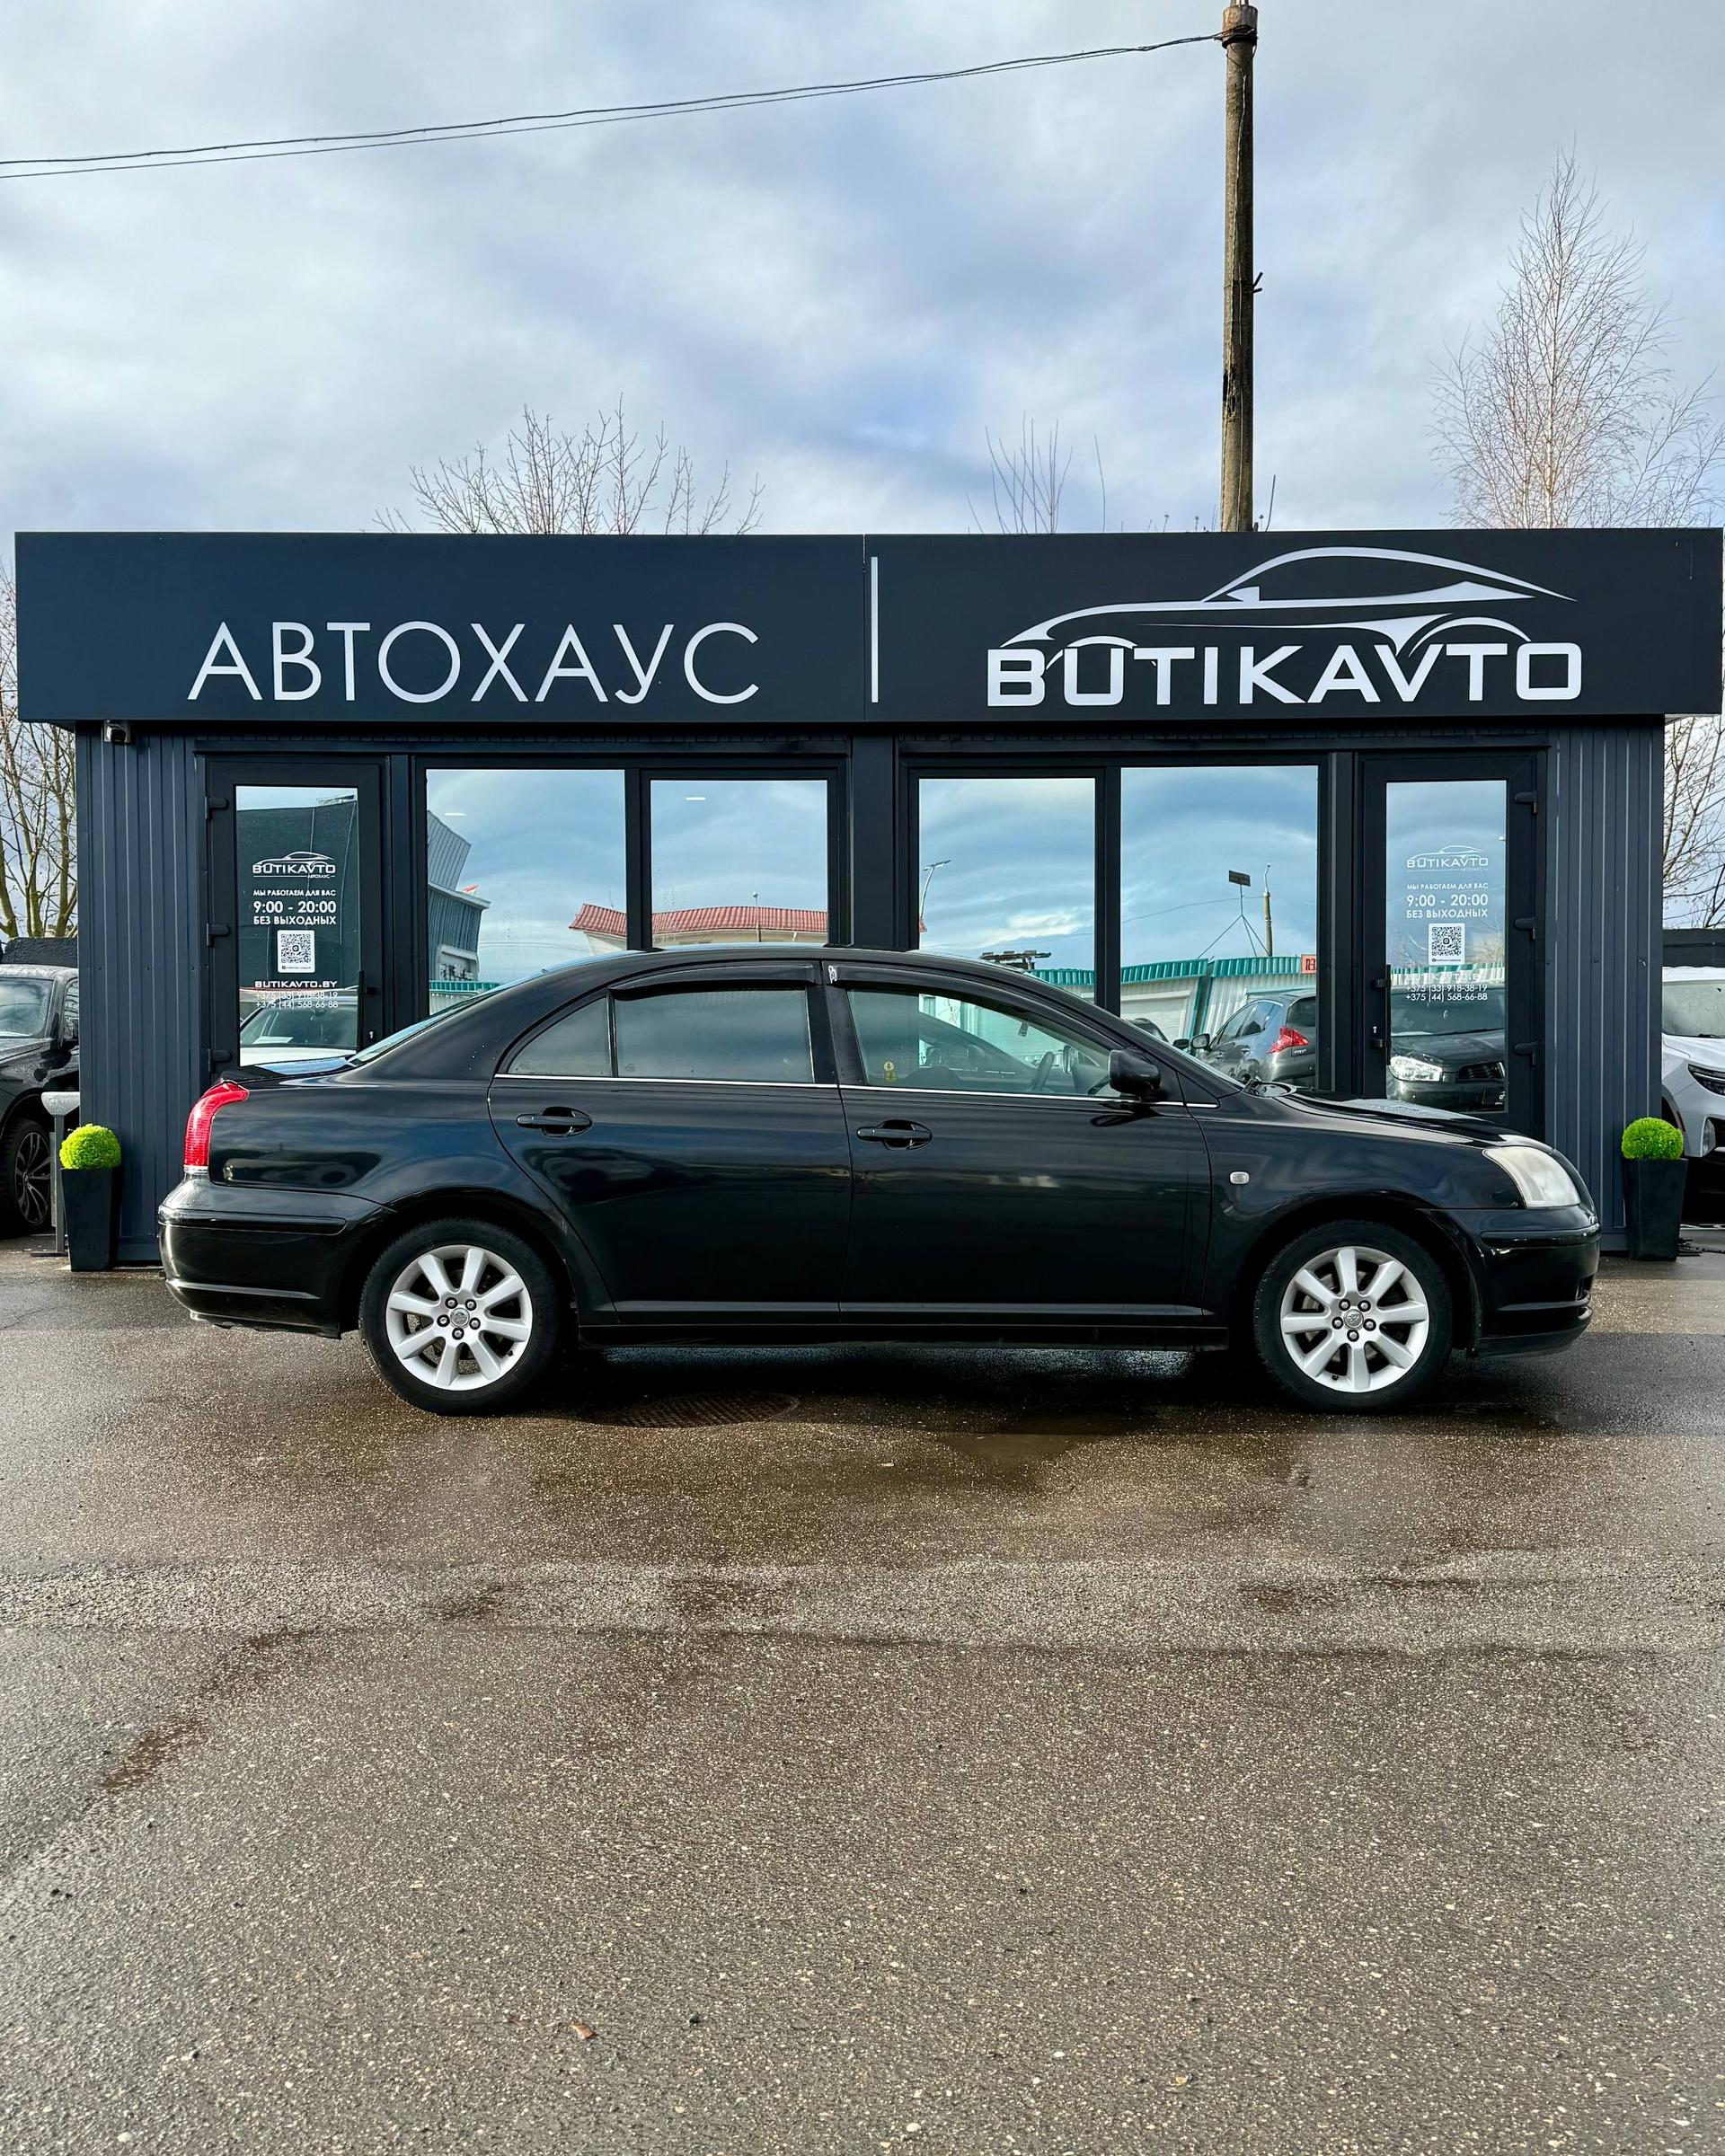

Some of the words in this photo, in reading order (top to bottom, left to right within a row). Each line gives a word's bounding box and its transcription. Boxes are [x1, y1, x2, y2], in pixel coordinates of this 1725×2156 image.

[187, 620, 759, 704] АВТОХАУС
[987, 641, 1582, 707] BUTIKAVTO
[1406, 858, 1489, 868] BUTIKAVTO
[252, 864, 336, 874] BUTIKAVTO
[1407, 894, 1436, 907] 9:00
[1450, 893, 1488, 906] 20:00
[253, 900, 284, 914] 9:00
[297, 900, 337, 914] 20:00
[1406, 909, 1423, 918] БЕЗ
[1426, 908, 1488, 918] ВЫХОДНЫХ
[253, 915, 270, 925] БЕЗ
[273, 915, 337, 926] ВЫХОДНЫХ
[254, 980, 338, 988] BUTIKAVTO.BY
[1406, 984, 1427, 993] +375
[1429, 984, 1444, 994] (33)
[1446, 984, 1488, 993] 918-38-19
[1405, 993, 1426, 1002] +375
[1429, 993, 1445, 1003] (44)
[1446, 993, 1488, 1001] 568-66-88
[256, 1000, 277, 1009] +375
[279, 1000, 295, 1010] (44)
[297, 1000, 339, 1009] 568-66-88
